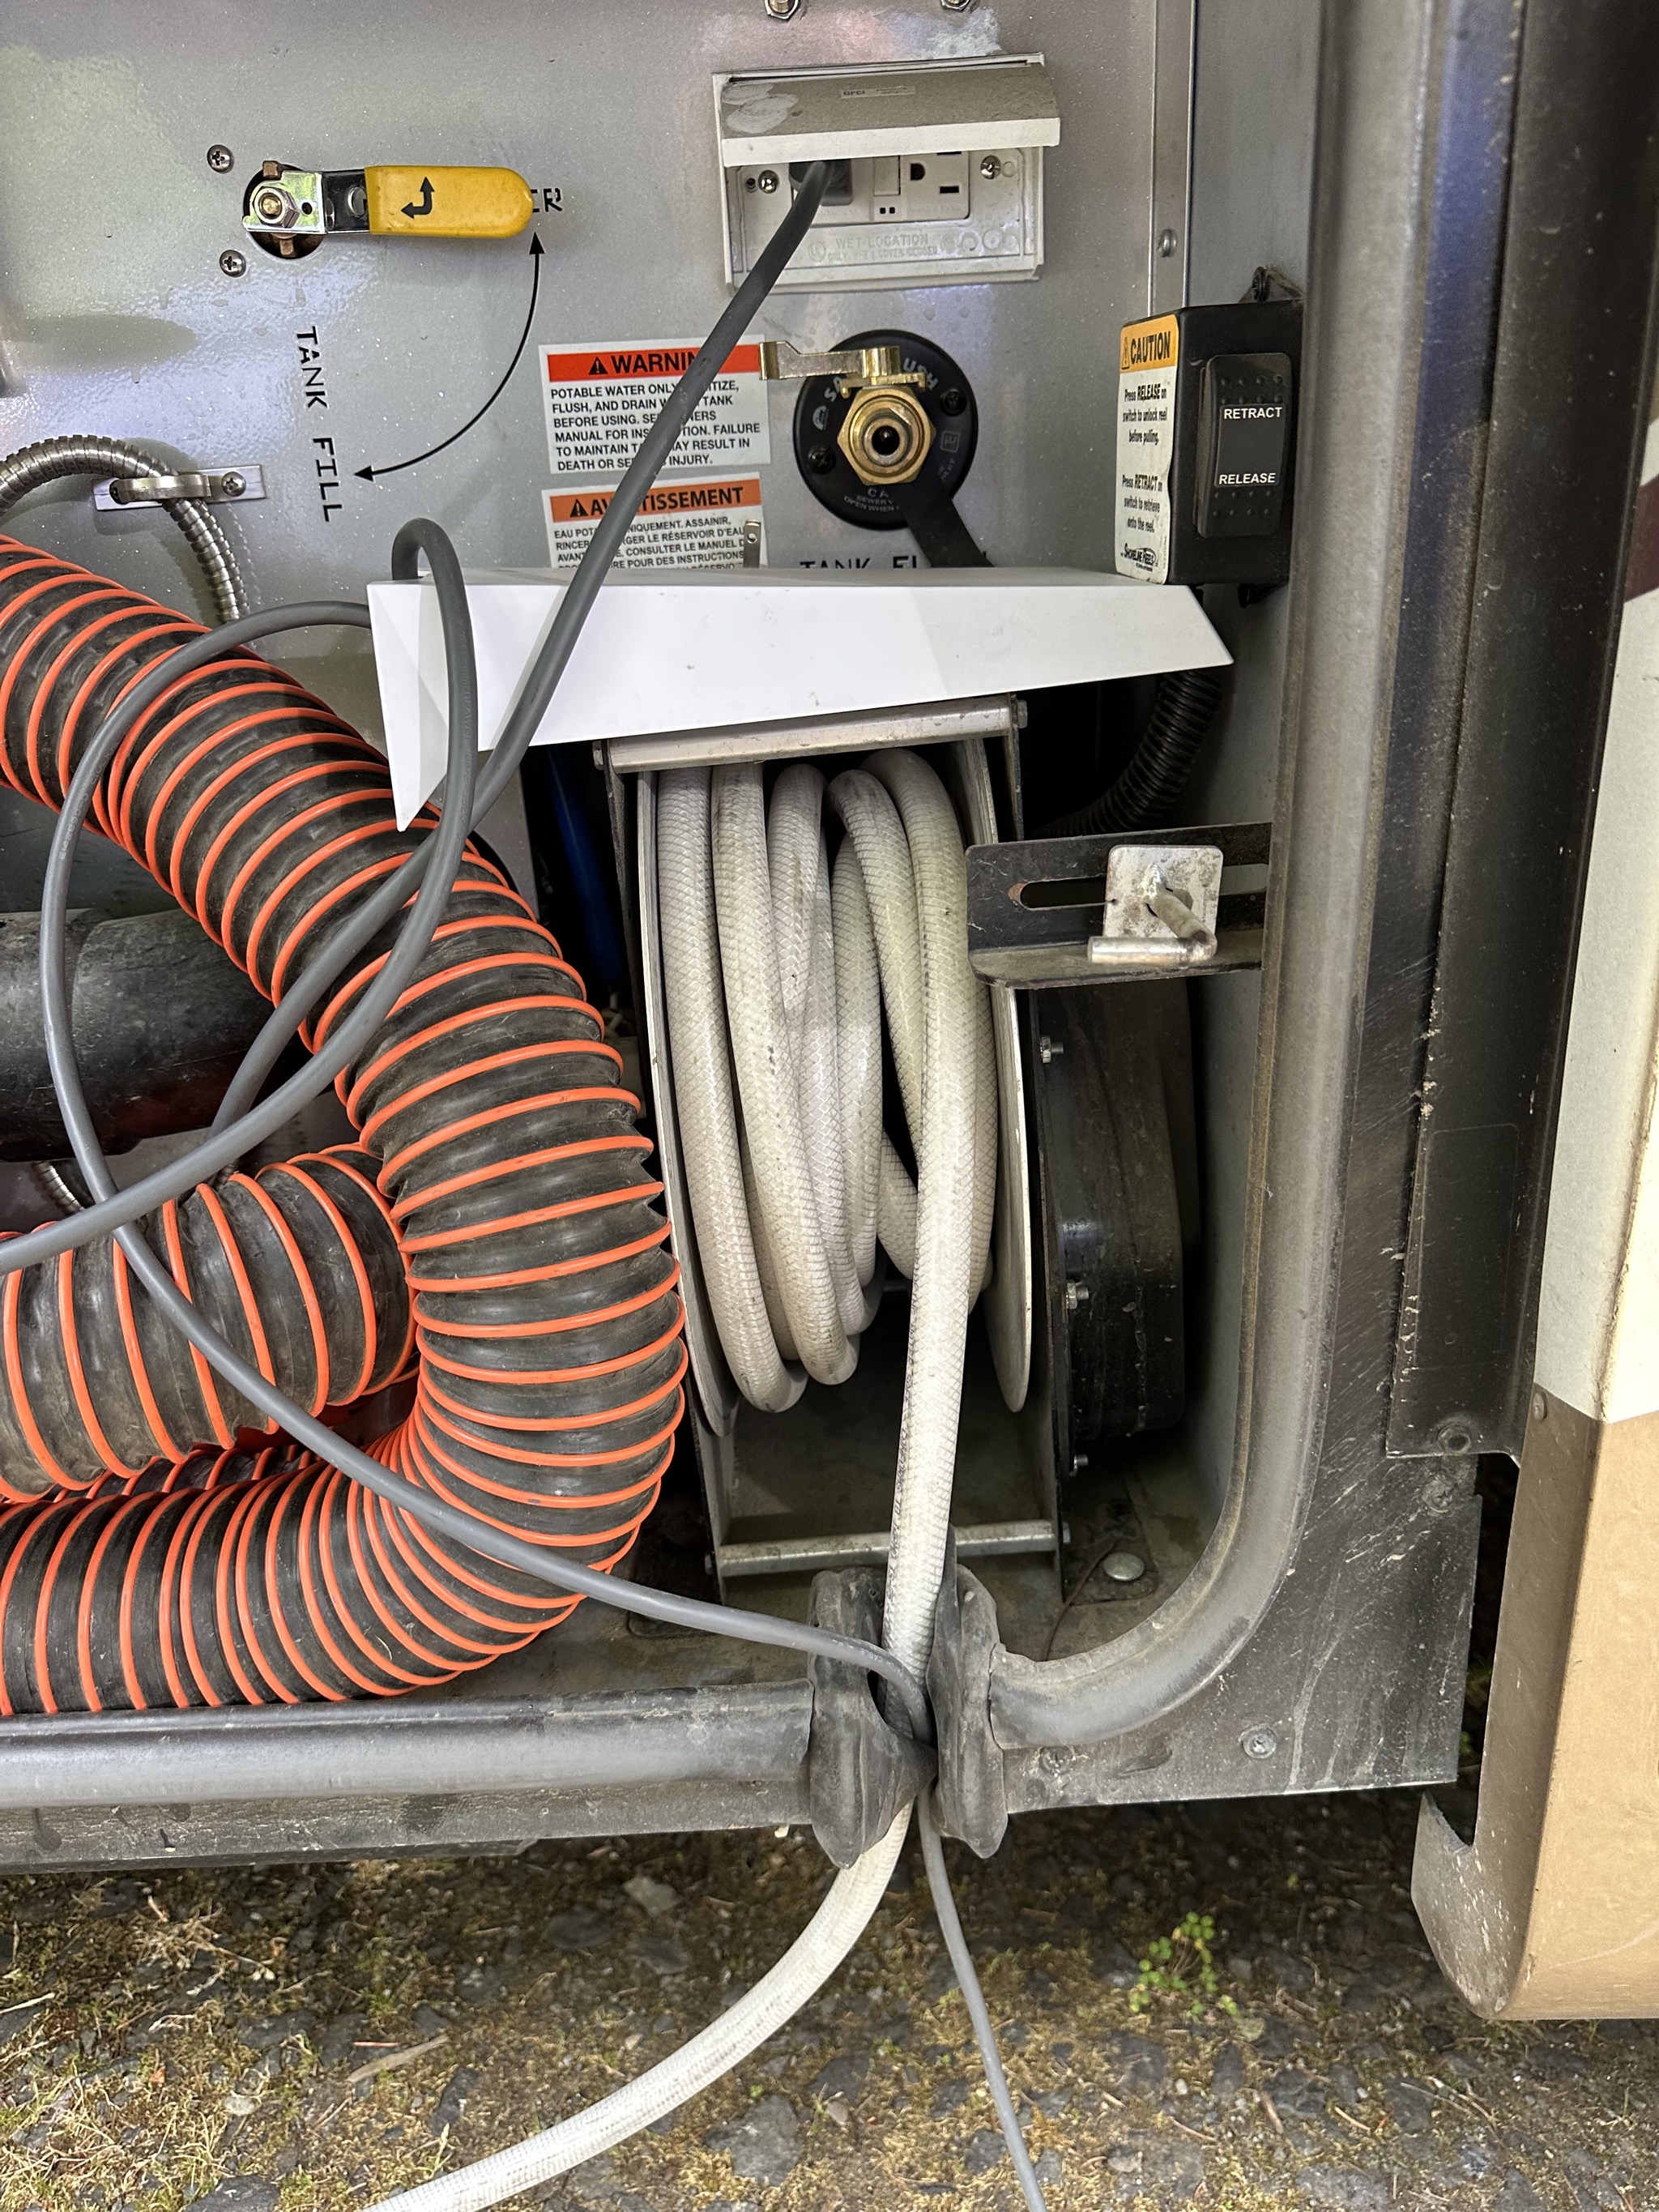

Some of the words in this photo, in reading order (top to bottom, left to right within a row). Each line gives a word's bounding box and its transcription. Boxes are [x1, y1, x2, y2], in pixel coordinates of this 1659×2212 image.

[835, 237, 862, 249] WET
[868, 233, 929, 248] LOCATION
[1130, 331, 1171, 365] CAUTION
[296, 326, 330, 409] TANK
[551, 386, 603, 399] POTABLE
[605, 385, 646, 397] WATER
[1124, 388, 1137, 403] Press
[1137, 383, 1161, 401] RELEASE
[1161, 388, 1167, 399] on
[552, 402, 592, 414] FLUSH,
[595, 400, 619, 412] AND
[622, 399, 657, 410] DRAIN
[702, 395, 733, 407] TANK
[1224, 407, 1282, 420] RETRACT
[553, 416, 599, 429] BEFORE
[601, 414, 640, 426] USING.
[1123, 408, 1137, 423] switch
[1137, 409, 1142, 422] to
[1143, 408, 1158, 422] unlock
[1158, 408, 1168, 421] reel
[555, 430, 603, 442] MANUAL
[606, 429, 629, 440] FOR
[714, 423, 761, 435] FAILURE
[1128, 429, 1143, 442] before
[556, 446, 572, 457] TO
[574, 444, 629, 456] MAINTAIN
[693, 438, 736, 451] RESULT
[739, 438, 750, 448] IN
[557, 459, 595, 472] DEATH
[598, 459, 615, 469] OR
[669, 454, 713, 467] INJURY.
[312, 437, 343, 523] FILL
[1122, 474, 1134, 488] Press
[1134, 474, 1158, 491] RETRACT
[1158, 481, 1162, 492] on
[1218, 472, 1276, 485] RELEASE
[1124, 495, 1138, 510] switch
[1143, 497, 1160, 513] retrieve
[554, 529, 574, 539] EAU
[648, 534, 659, 543] LE
[662, 529, 714, 542] RÉSERVOIR
[626, 544, 682, 557] CONSULTER
[684, 542, 696, 552] LE
[698, 539, 738, 551] MANUEL
[656, 557, 676, 566] DES
